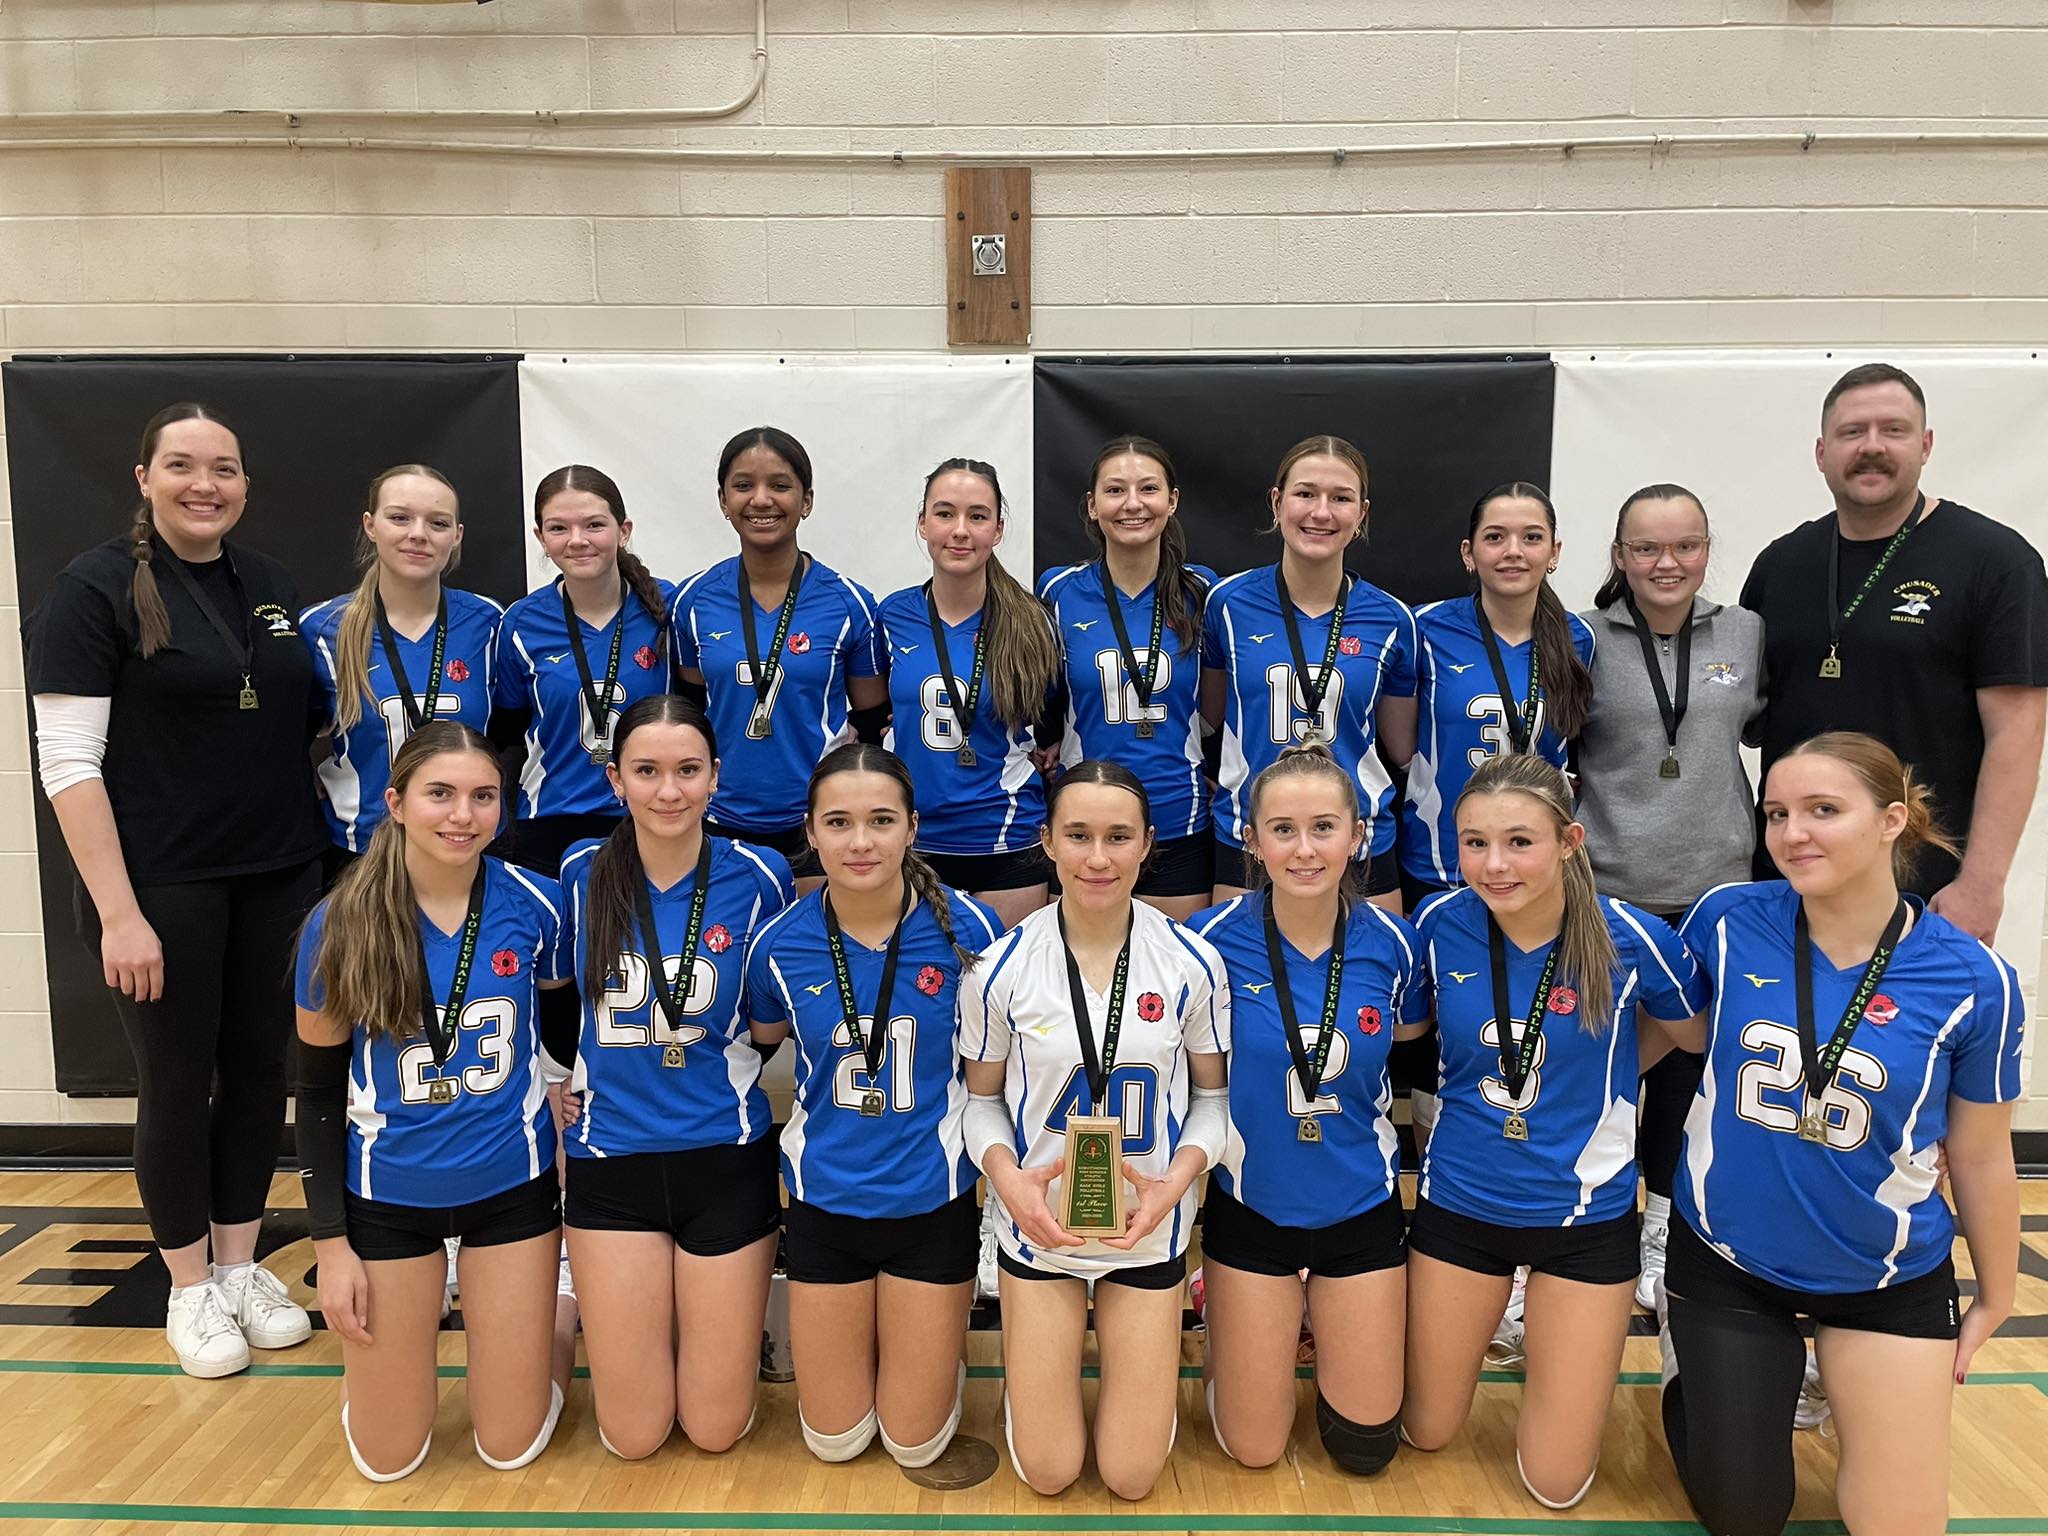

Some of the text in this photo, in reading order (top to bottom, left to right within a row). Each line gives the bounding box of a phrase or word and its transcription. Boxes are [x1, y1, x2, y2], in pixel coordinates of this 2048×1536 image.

[1864, 527, 1911, 588] VOLLEYBALL
[1893, 580, 1941, 597] CRUSADER
[431, 625, 446, 687] VOLLEYBALL
[774, 592, 796, 651] VOLLEYBALL
[974, 625, 986, 679] LLEYBALL
[1151, 598, 1162, 651] LLEYBALL
[1326, 605, 1344, 663] VOLLEYBALL
[736, 660, 785, 740] 7
[919, 674, 970, 752] 8
[1095, 648, 1171, 725] 12
[1266, 663, 1345, 744] 19
[446, 913, 479, 1034] VOLLEYBALL 2025
[675, 888, 705, 1005] VOLLEYBALL 2025
[830, 935, 861, 1045] VOLLEYBALL 20
[594, 951, 718, 1047] 22
[1105, 951, 1128, 1075] VOLLEYBALL 2025
[1316, 953, 1342, 1074] VOLLEYBALL 2025
[1521, 952, 1557, 1075] VOLLEYBALL 2025
[1824, 948, 1890, 1070] VOLLEYBALL 2025
[397, 996, 518, 1105] 23
[832, 1015, 917, 1112] 21
[1286, 1024, 1350, 1118] 2
[1478, 1018, 1547, 1112] 3
[1736, 1019, 1888, 1152] 26
[1043, 1063, 1159, 1157] 40
